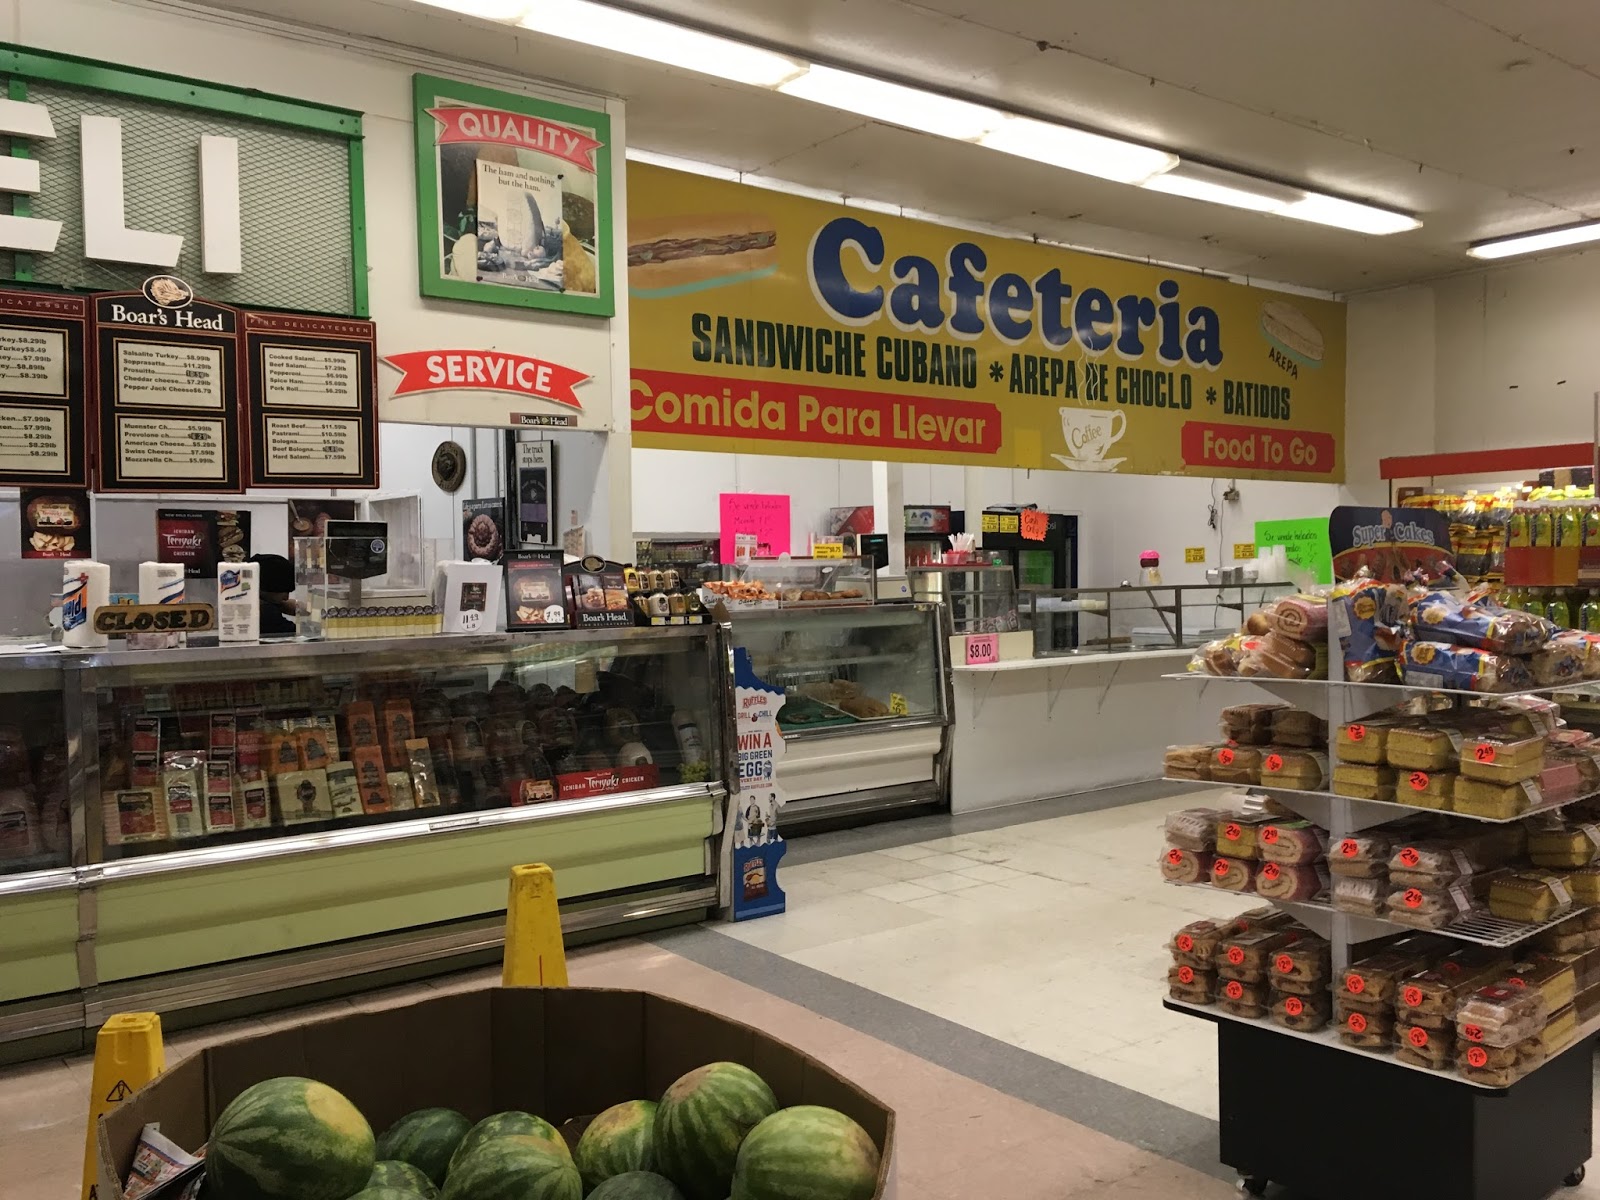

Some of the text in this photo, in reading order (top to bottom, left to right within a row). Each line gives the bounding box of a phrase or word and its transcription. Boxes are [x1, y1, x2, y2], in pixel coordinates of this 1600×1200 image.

[458, 112, 580, 156] QUALITY
[482, 164, 555, 188] The ham and nothing
[498, 177, 510, 185] but
[511, 180, 523, 188] the
[808, 217, 1224, 369] Cafeteria
[111, 303, 224, 331] Boar's Head
[284, 321, 368, 333] DELICATESSEN
[155, 352, 179, 360] Turkey
[268, 353, 293, 361] Cooked
[1268, 346, 1298, 379] AREPA
[269, 369, 301, 377] Pepperoni
[426, 355, 553, 392] SERVICE
[691, 313, 1291, 420] SANDWICHE CUBANO AREPA DE CHOCLO BATIDOS
[123, 383, 148, 391] Pepper
[630, 379, 986, 445] Comida Para Llevar
[550, 417, 568, 426] Head
[1071, 424, 1102, 449] Coffee
[1203, 430, 1317, 466] Food To Go
[162, 533, 202, 548] Teriyaki
[1352, 521, 1436, 549] Super Cakes
[96, 609, 210, 631] CLOSED
[582, 612, 628, 622] Boar's Head
[970, 643, 992, 659] $8.00
[742, 695, 768, 709] RUFFLES
[737, 732, 772, 750] WIN A
[737, 750, 773, 761] BIG GREEN
[1477, 746, 1493, 760] 249
[738, 760, 763, 778] EGG
[563, 783, 586, 791] ICHIBAN
[584, 774, 620, 789] Teriyaki
[621, 775, 645, 784] CHICKEN
[1411, 773, 1426, 787] 249
[1227, 825, 1240, 837] 249
[1264, 830, 1277, 840] 249
[1343, 843, 1357, 853] 249
[1402, 850, 1418, 864] 249
[1216, 861, 1228, 871] 249
[1265, 865, 1278, 877] 249
[1405, 890, 1421, 902] 249
